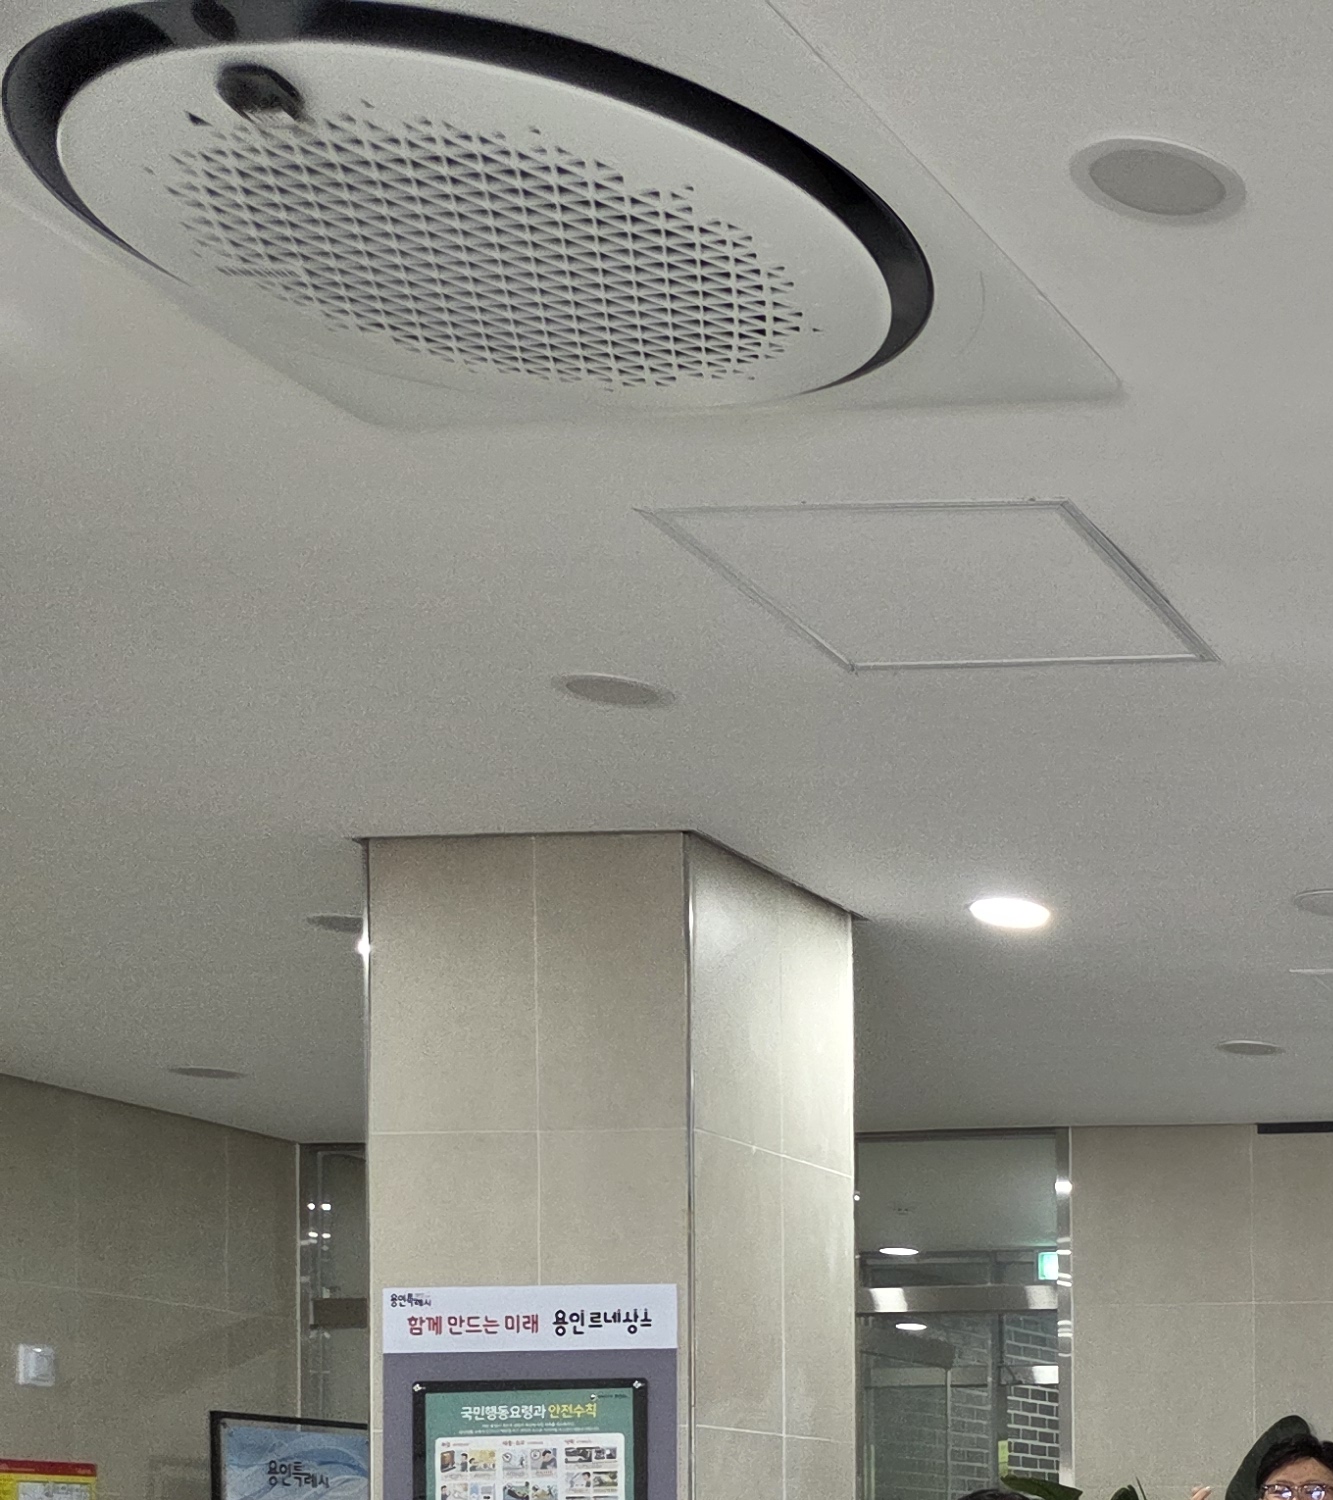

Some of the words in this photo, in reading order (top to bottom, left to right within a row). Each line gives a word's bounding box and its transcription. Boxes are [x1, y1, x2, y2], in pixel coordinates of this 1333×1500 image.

[407, 1315, 443, 1335] 함께
[448, 1315, 500, 1335] 만드는
[504, 1313, 539, 1333] 미래
[552, 1309, 586, 1337] 용인
[588, 1308, 652, 1334] 르네상스
[460, 1403, 546, 1421] 국민행동요령과
[548, 1402, 597, 1419] 안전수칙
[267, 1460, 330, 1488] 용인특례시
